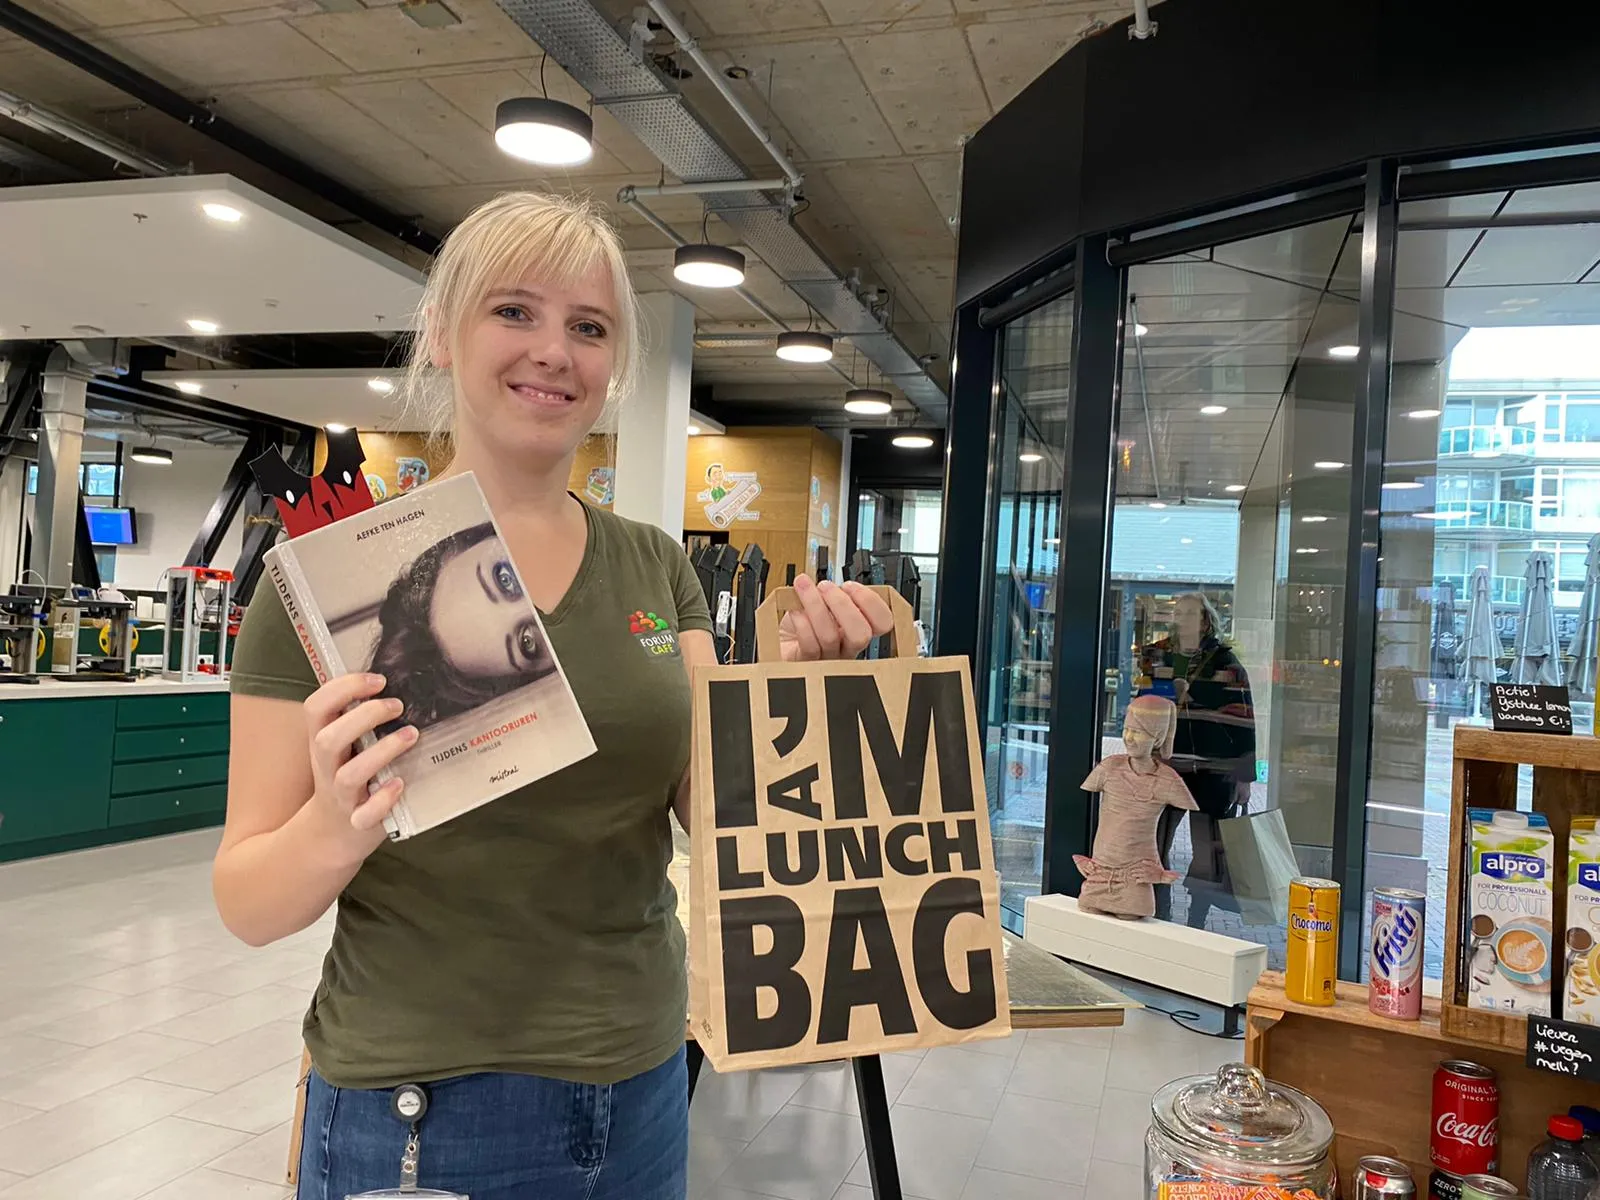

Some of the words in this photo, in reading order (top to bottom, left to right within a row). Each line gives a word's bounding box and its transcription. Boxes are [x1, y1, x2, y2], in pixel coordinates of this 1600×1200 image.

[356, 528, 381, 541] AEFKE
[381, 521, 395, 532] TEN
[397, 509, 425, 526] HAGEN
[271, 564, 299, 620] TIJDENS
[640, 634, 675, 648] FORUM
[431, 743, 468, 764] TIJDENS
[469, 711, 538, 747] KANTOORUREN
[708, 670, 976, 829] I'M
[489, 765, 519, 783] mistral
[767, 762, 823, 821] A
[716, 819, 981, 891] LUNCH
[1486, 854, 1540, 875] alpro
[1492, 884, 1547, 895] PROFESSIONALS
[1478, 892, 1549, 915] COCONUT
[719, 877, 997, 1055] BAG
[1445, 1079, 1489, 1095] ORIGINAL
[1462, 1094, 1484, 1102] SINCE
[1434, 1178, 1457, 1193] ZERO
